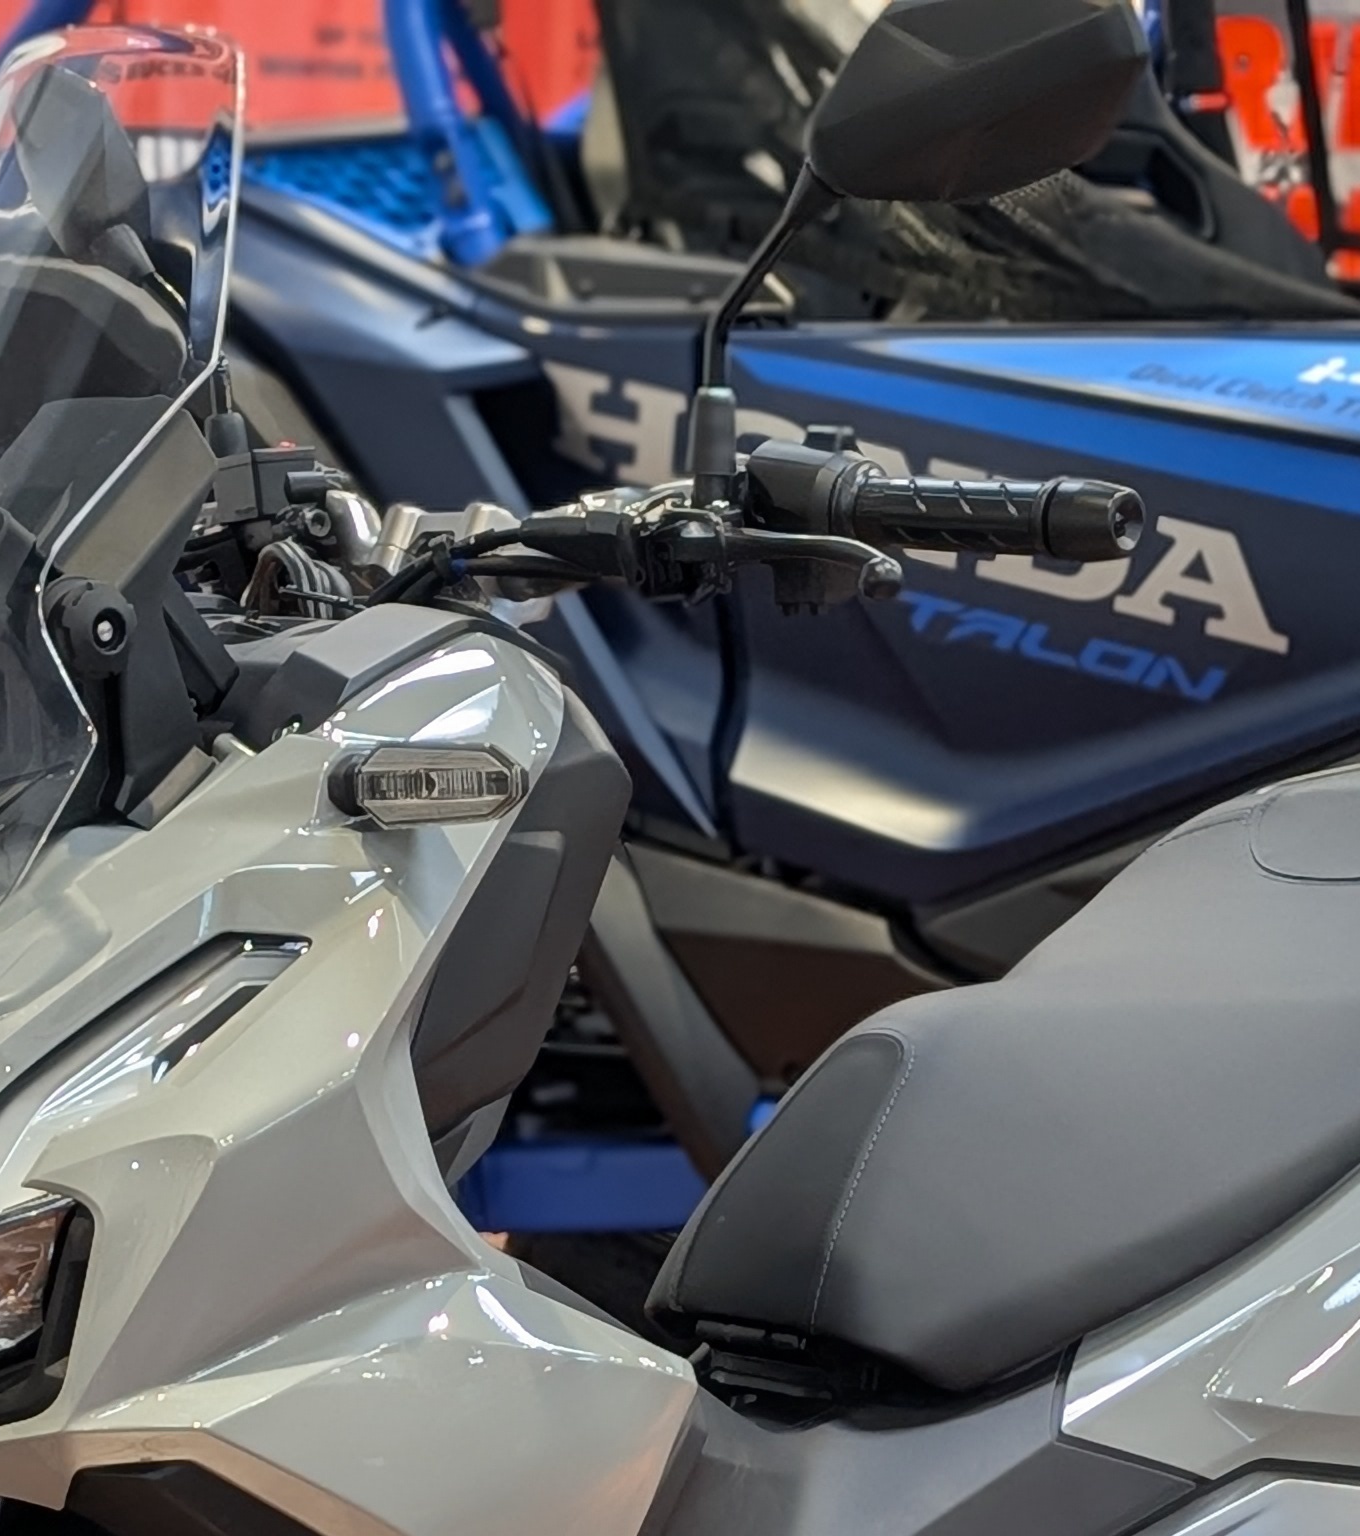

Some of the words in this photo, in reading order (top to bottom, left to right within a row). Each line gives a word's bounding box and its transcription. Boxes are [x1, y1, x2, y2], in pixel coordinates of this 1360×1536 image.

[1129, 361, 1212, 394] Dual
[1216, 372, 1329, 411] Clutch
[900, 592, 1227, 702] TALON
